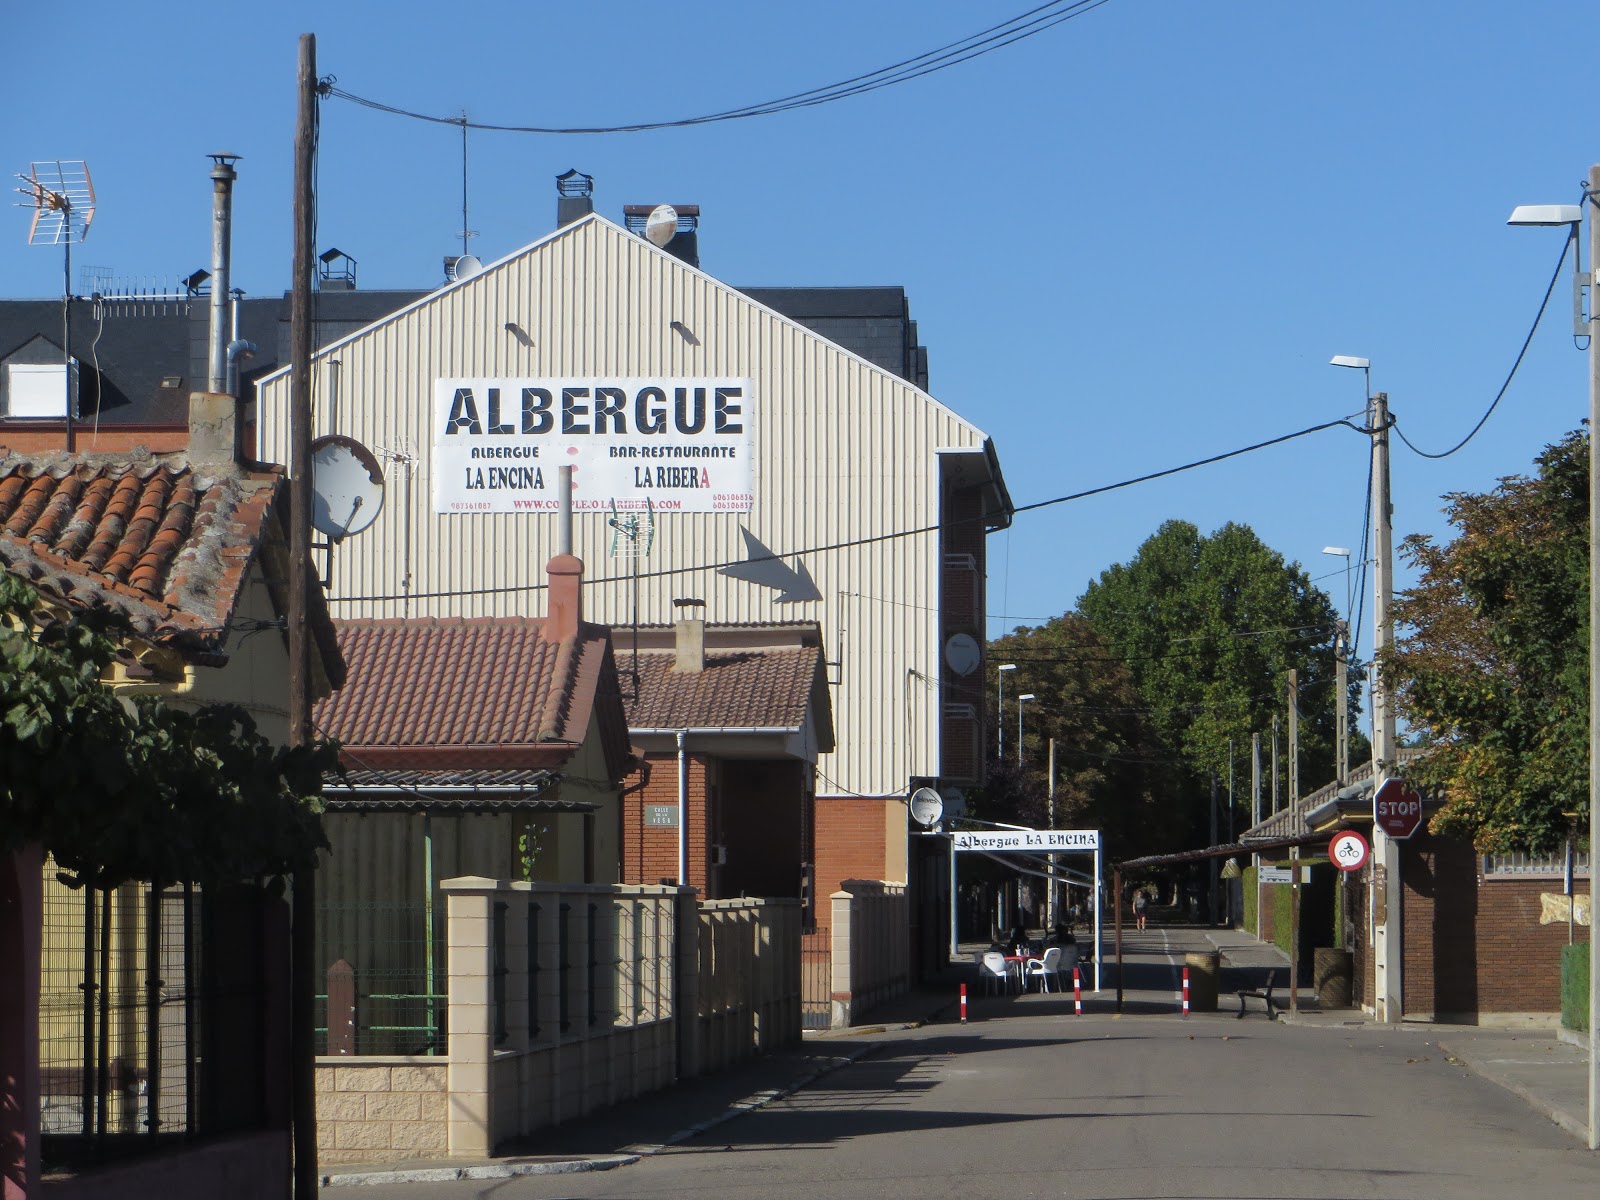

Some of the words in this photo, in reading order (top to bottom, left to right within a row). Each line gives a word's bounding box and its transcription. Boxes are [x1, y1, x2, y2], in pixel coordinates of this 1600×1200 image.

[445, 386, 743, 435] ALBERGUE
[471, 446, 539, 459] ALBERGUE
[609, 446, 736, 458] BAR-RESTAURANTE
[465, 467, 484, 489] LA
[488, 466, 545, 489] ENCINA
[634, 466, 654, 488] LA
[656, 466, 711, 489] RIBERA
[513, 500, 599, 509] WWW.COPLEJO
[1378, 801, 1419, 816] STOP
[959, 835, 1020, 849] Albergue
[1026, 834, 1043, 845] LA
[1048, 833, 1096, 845] ENCINA
